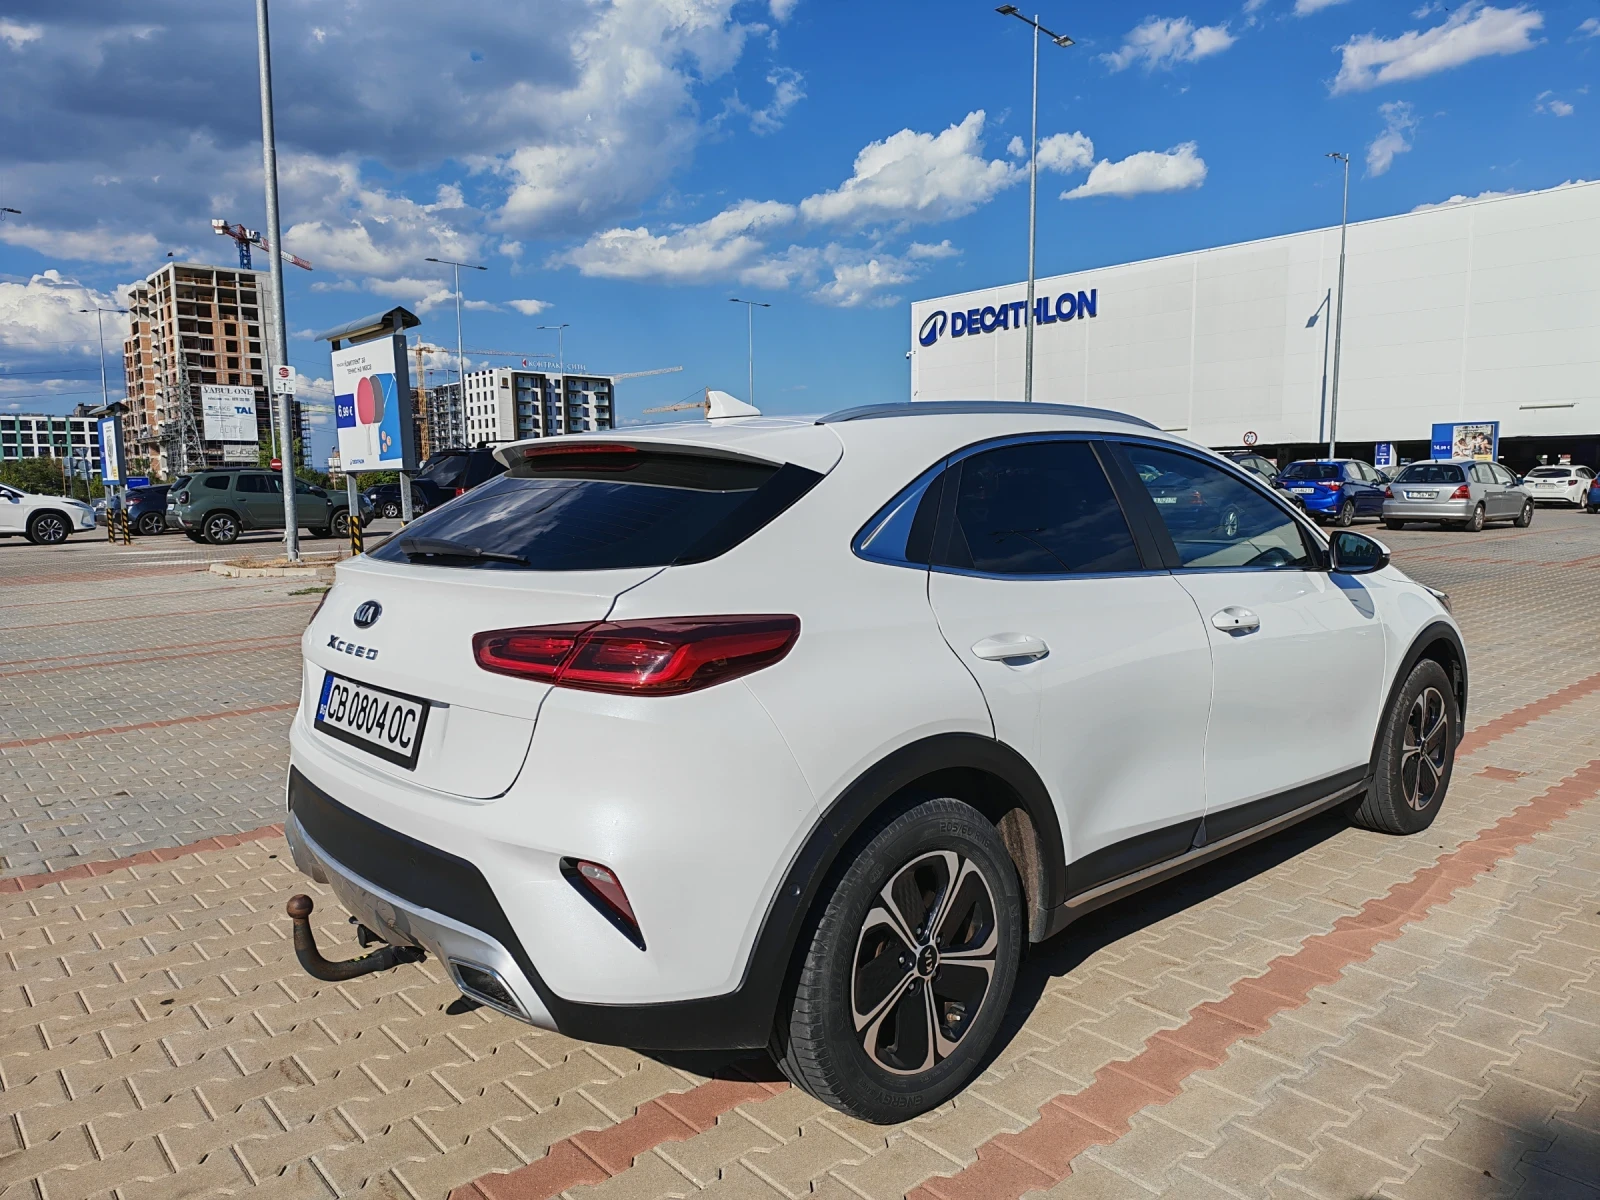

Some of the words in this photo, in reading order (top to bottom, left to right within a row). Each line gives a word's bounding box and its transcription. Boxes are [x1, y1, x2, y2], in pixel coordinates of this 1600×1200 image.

[951, 288, 1098, 338] DECATHLON
[528, 360, 563, 369] КОНТРАК
[234, 388, 253, 396] ONE
[234, 406, 254, 415] TAL
[337, 404, 349, 419] 6,99
[355, 604, 375, 623] KIA
[326, 634, 379, 661] XCEED
